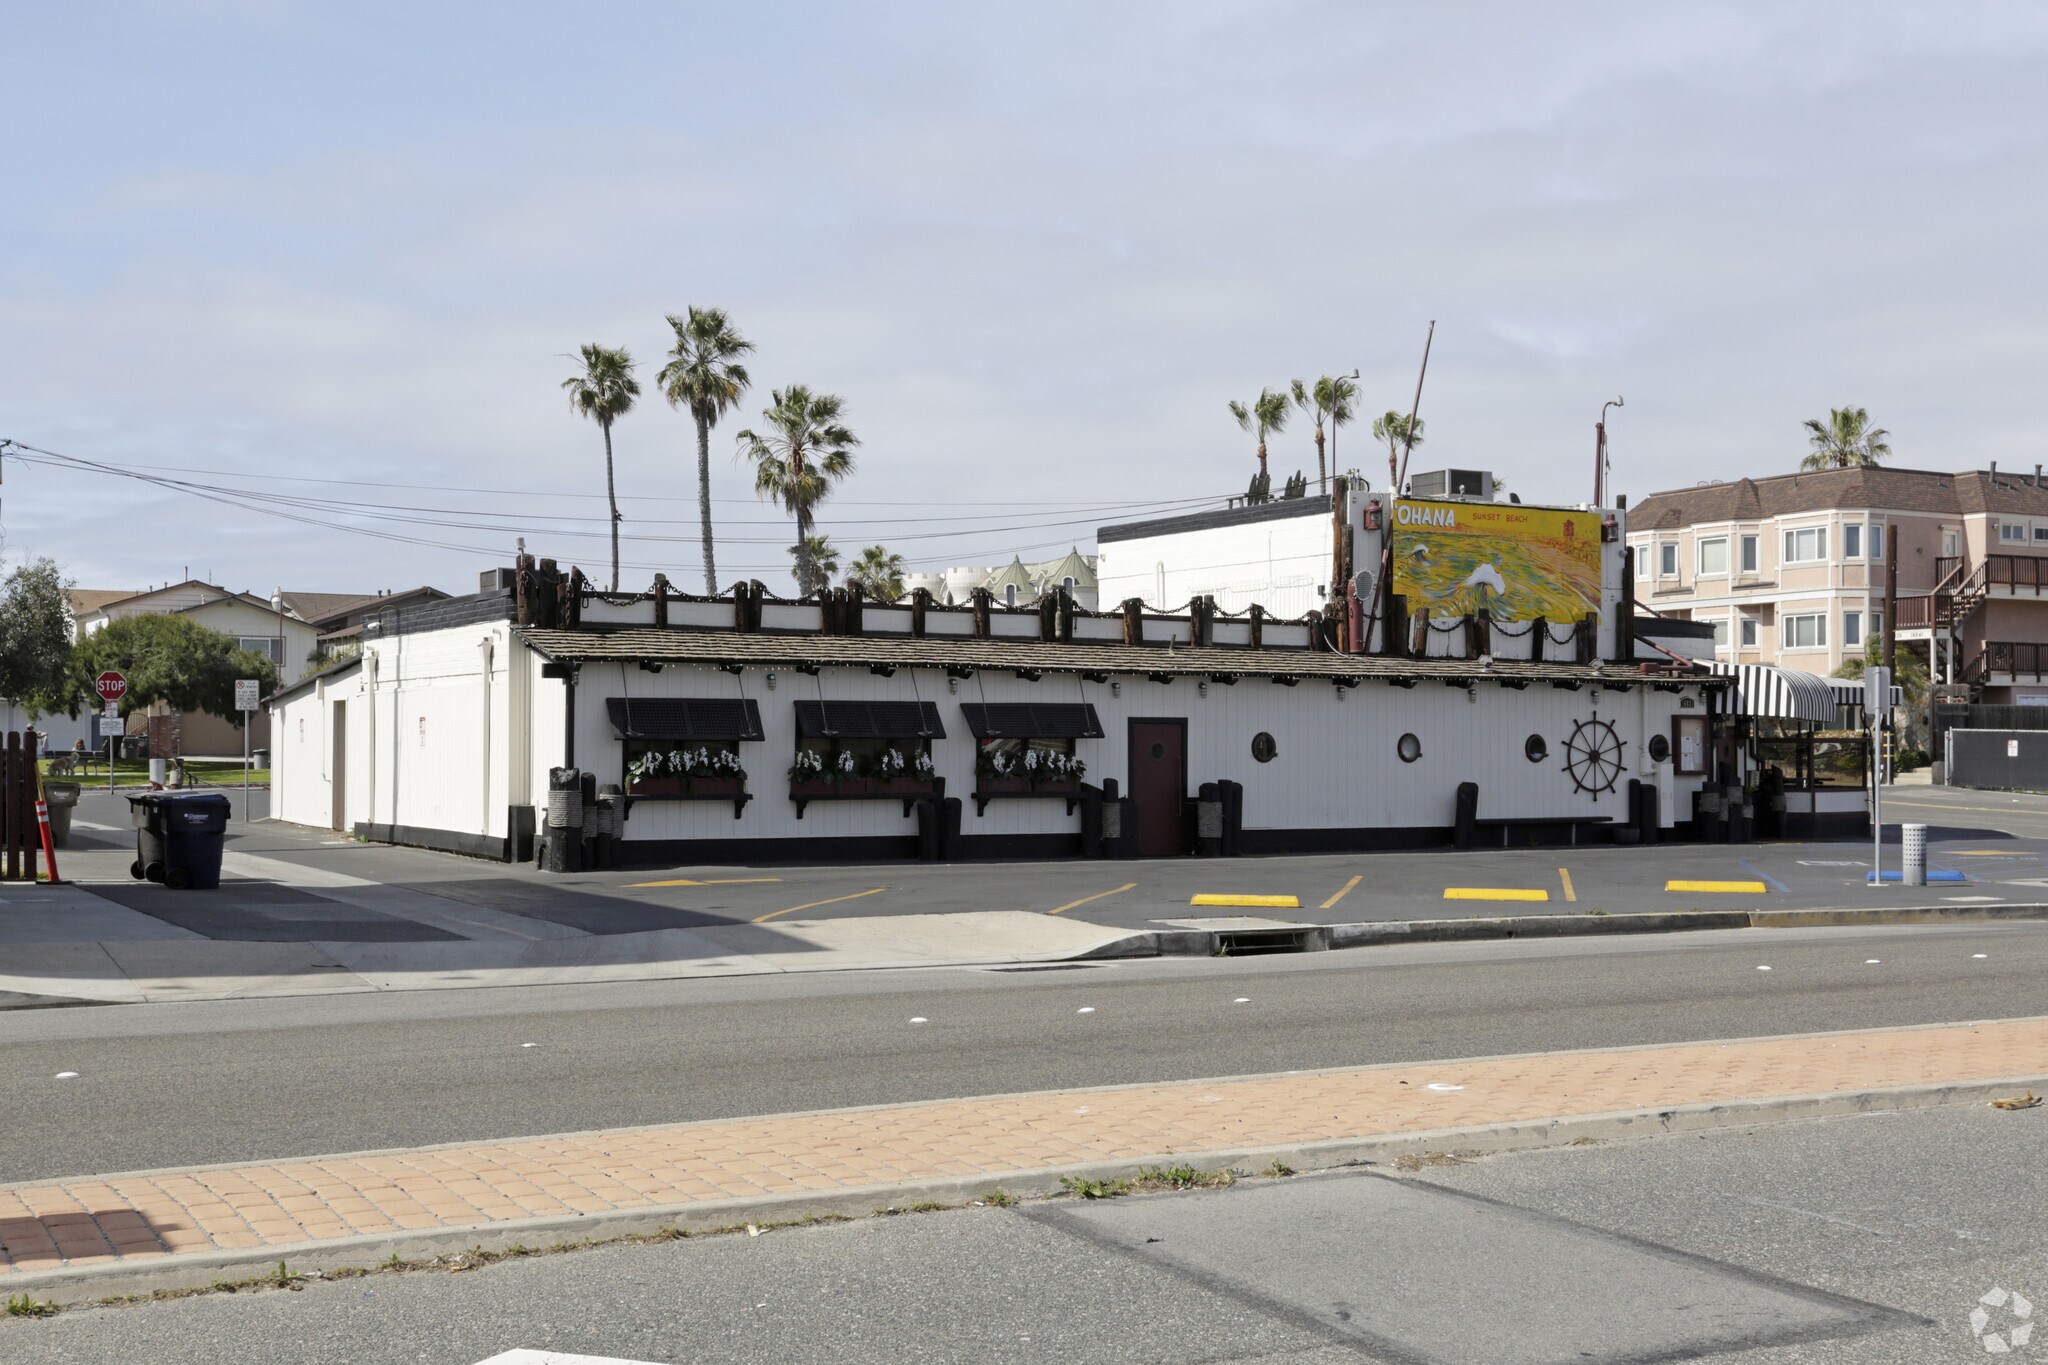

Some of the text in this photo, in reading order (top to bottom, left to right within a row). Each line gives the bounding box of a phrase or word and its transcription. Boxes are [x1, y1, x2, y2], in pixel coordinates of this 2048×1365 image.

[1472, 513, 1528, 523] SUNSET BEACH
[98, 680, 125, 691] STOP
